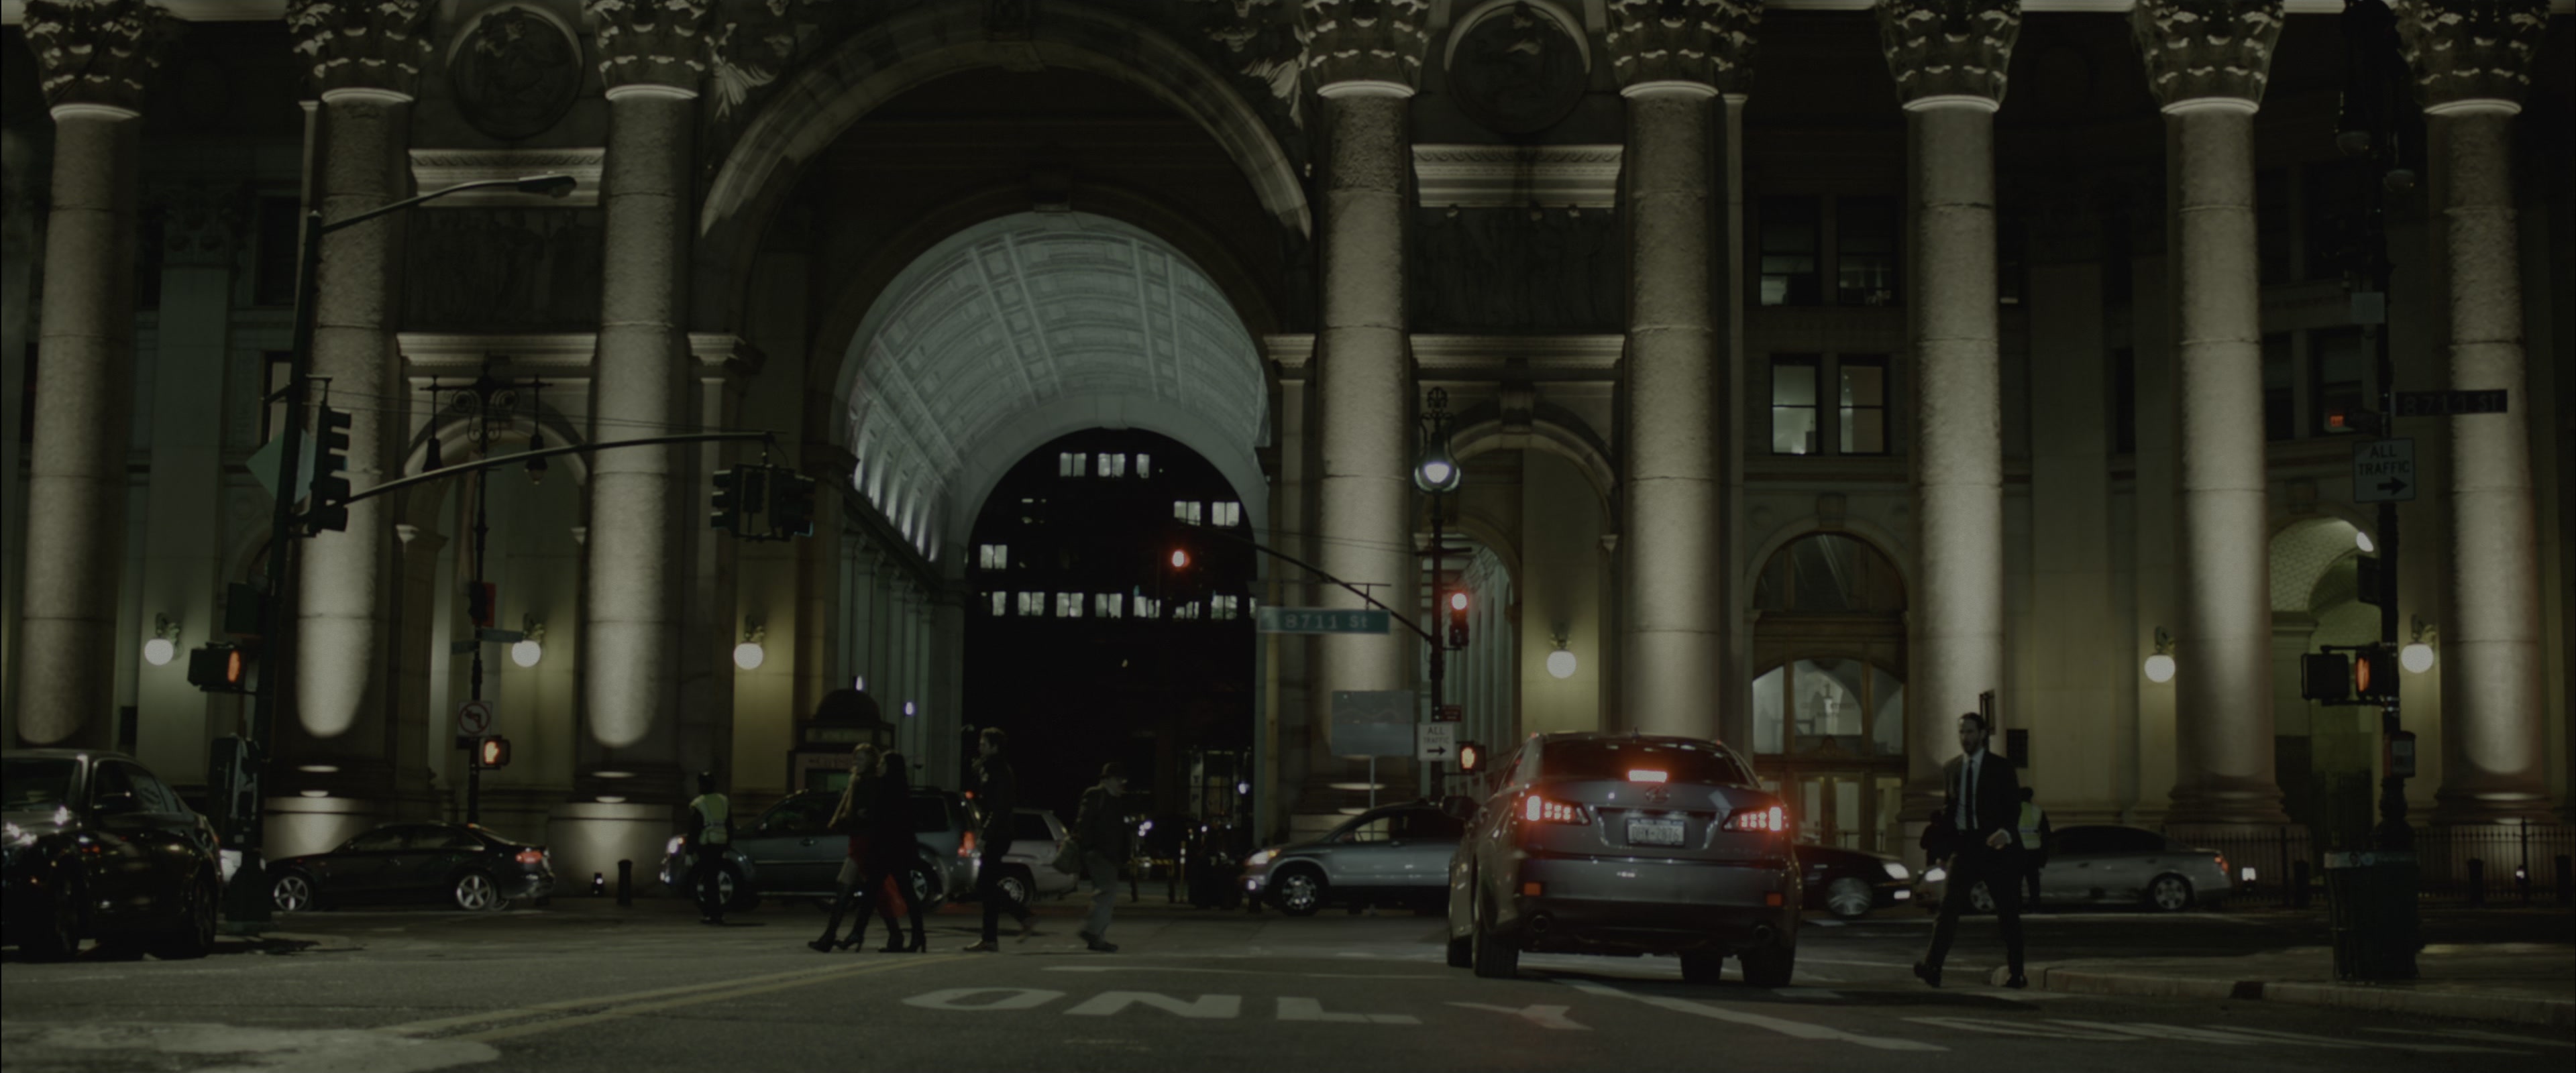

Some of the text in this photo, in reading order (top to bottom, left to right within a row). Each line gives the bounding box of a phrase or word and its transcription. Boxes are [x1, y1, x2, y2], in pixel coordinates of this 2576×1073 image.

[2404, 393, 2500, 414] 8711 ST
[2369, 444, 2397, 459] ALL
[2358, 460, 2410, 476] TRAFFIC
[1284, 613, 1369, 630] 8711 St
[1427, 726, 1445, 736] ALL
[901, 987, 1594, 1031] ONLY
